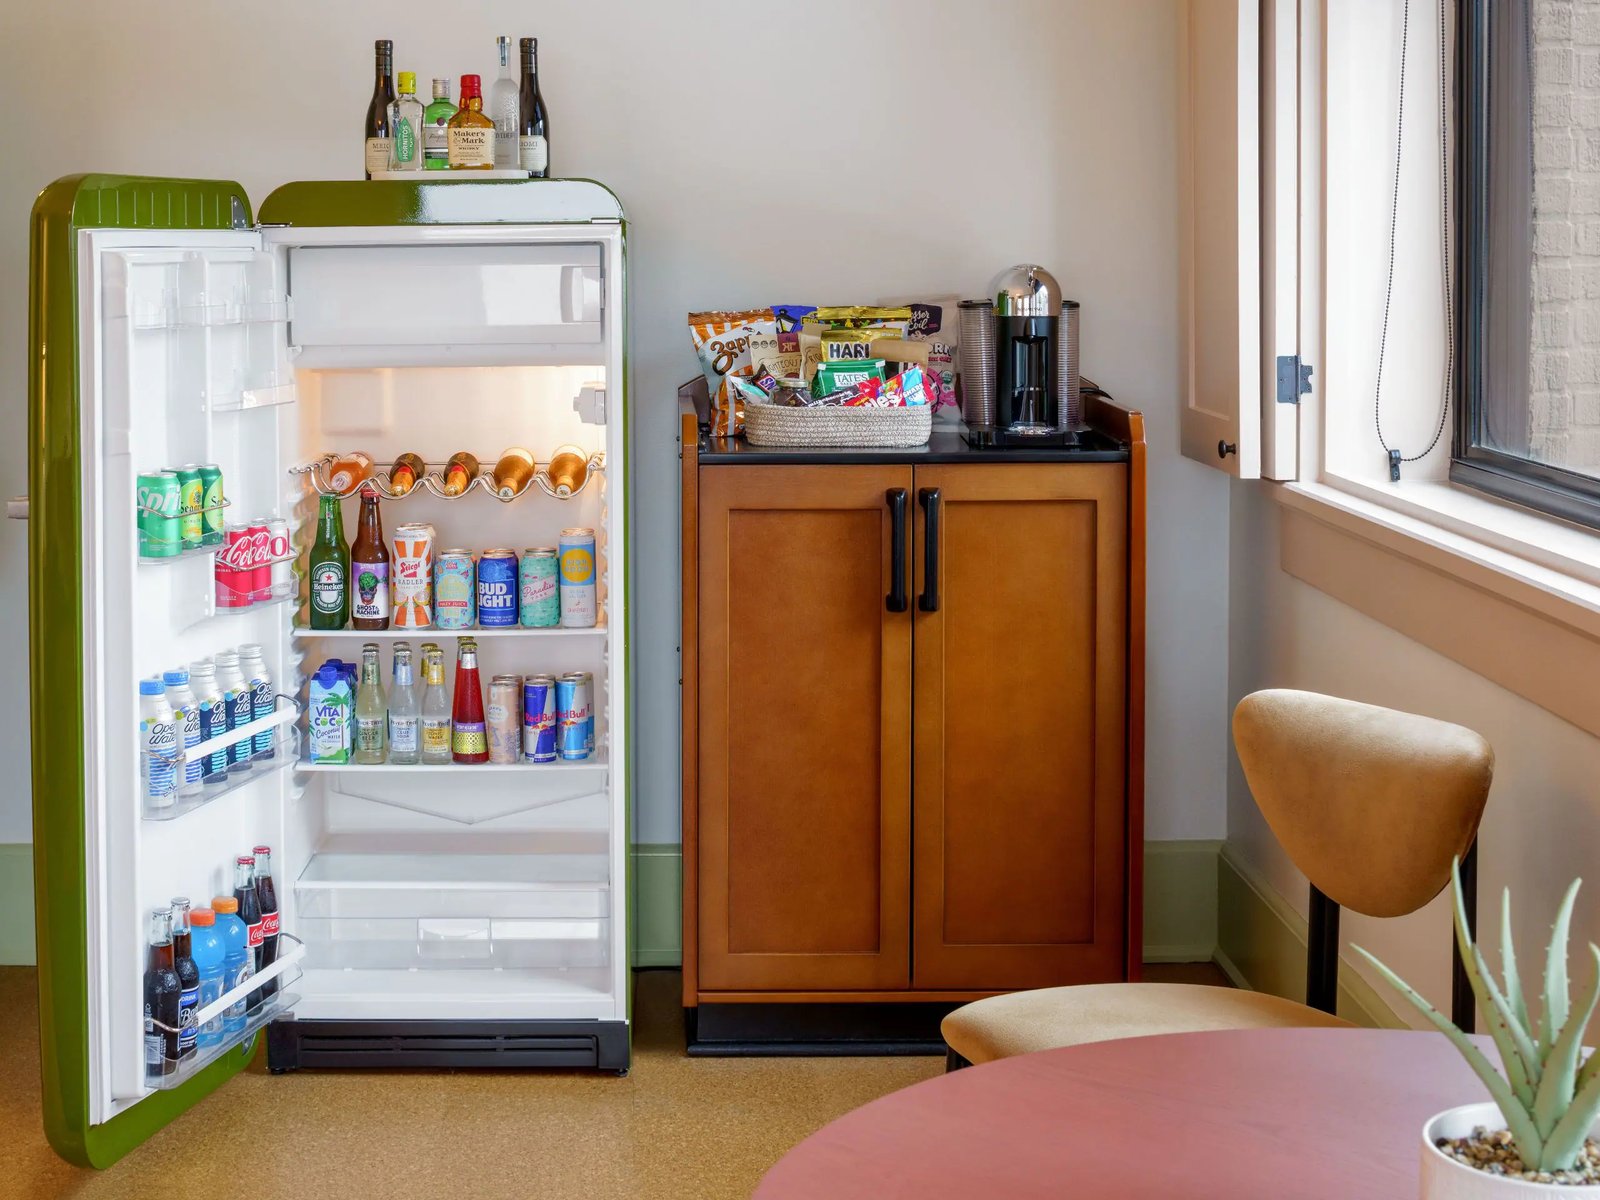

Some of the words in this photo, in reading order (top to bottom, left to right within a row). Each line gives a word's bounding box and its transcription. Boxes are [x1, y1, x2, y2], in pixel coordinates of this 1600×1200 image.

[829, 342, 870, 359] HARI
[835, 373, 868, 382] TATE'S
[479, 582, 507, 595] BUD
[523, 580, 555, 597] Paradise
[479, 595, 513, 608] IGHT
[316, 705, 340, 717] VITA
[525, 712, 540, 722] Red
[316, 727, 341, 739] Coconut
